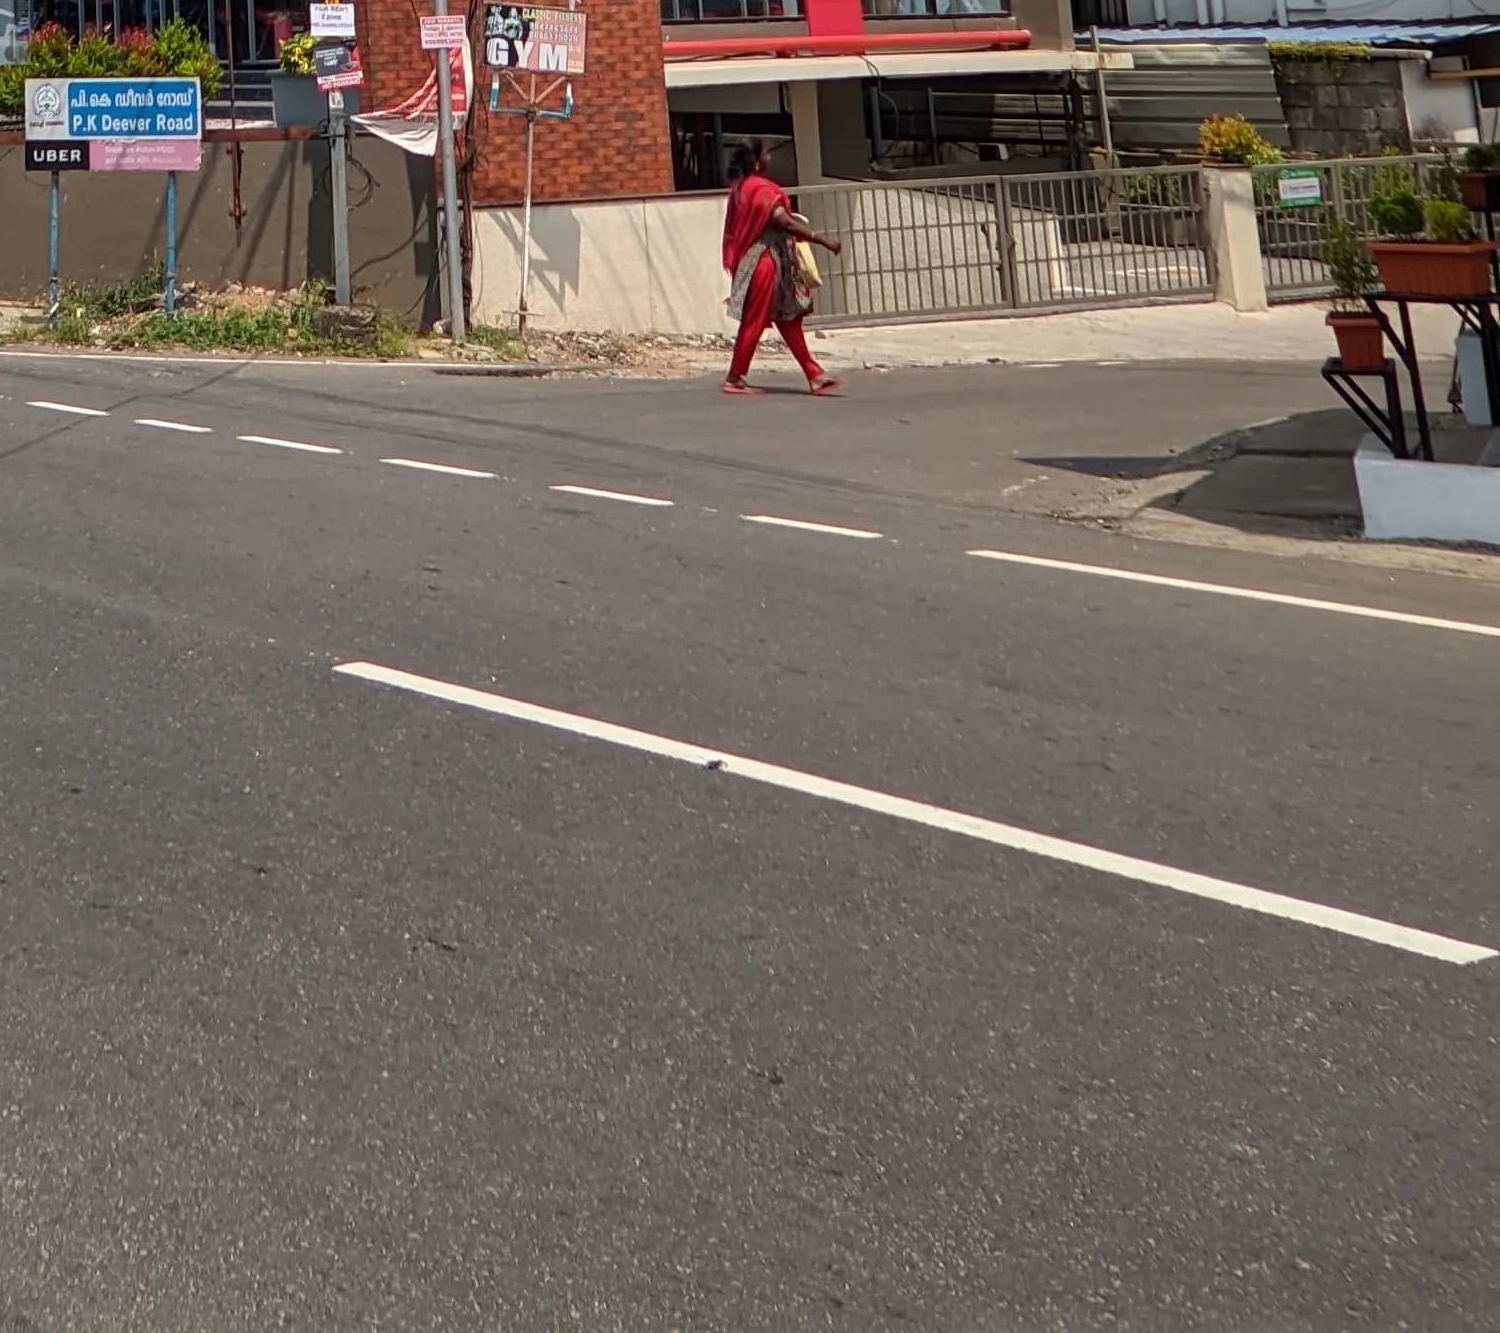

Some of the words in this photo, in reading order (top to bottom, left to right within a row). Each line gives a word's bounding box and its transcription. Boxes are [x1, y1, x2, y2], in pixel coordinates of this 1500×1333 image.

[486, 37, 568, 73] GYM
[156, 87, 195, 108] റോഡ്
[72, 113, 98, 132] P.K
[102, 113, 152, 133] Deever
[156, 112, 193, 132] Road
[33, 149, 82, 163] UBER
